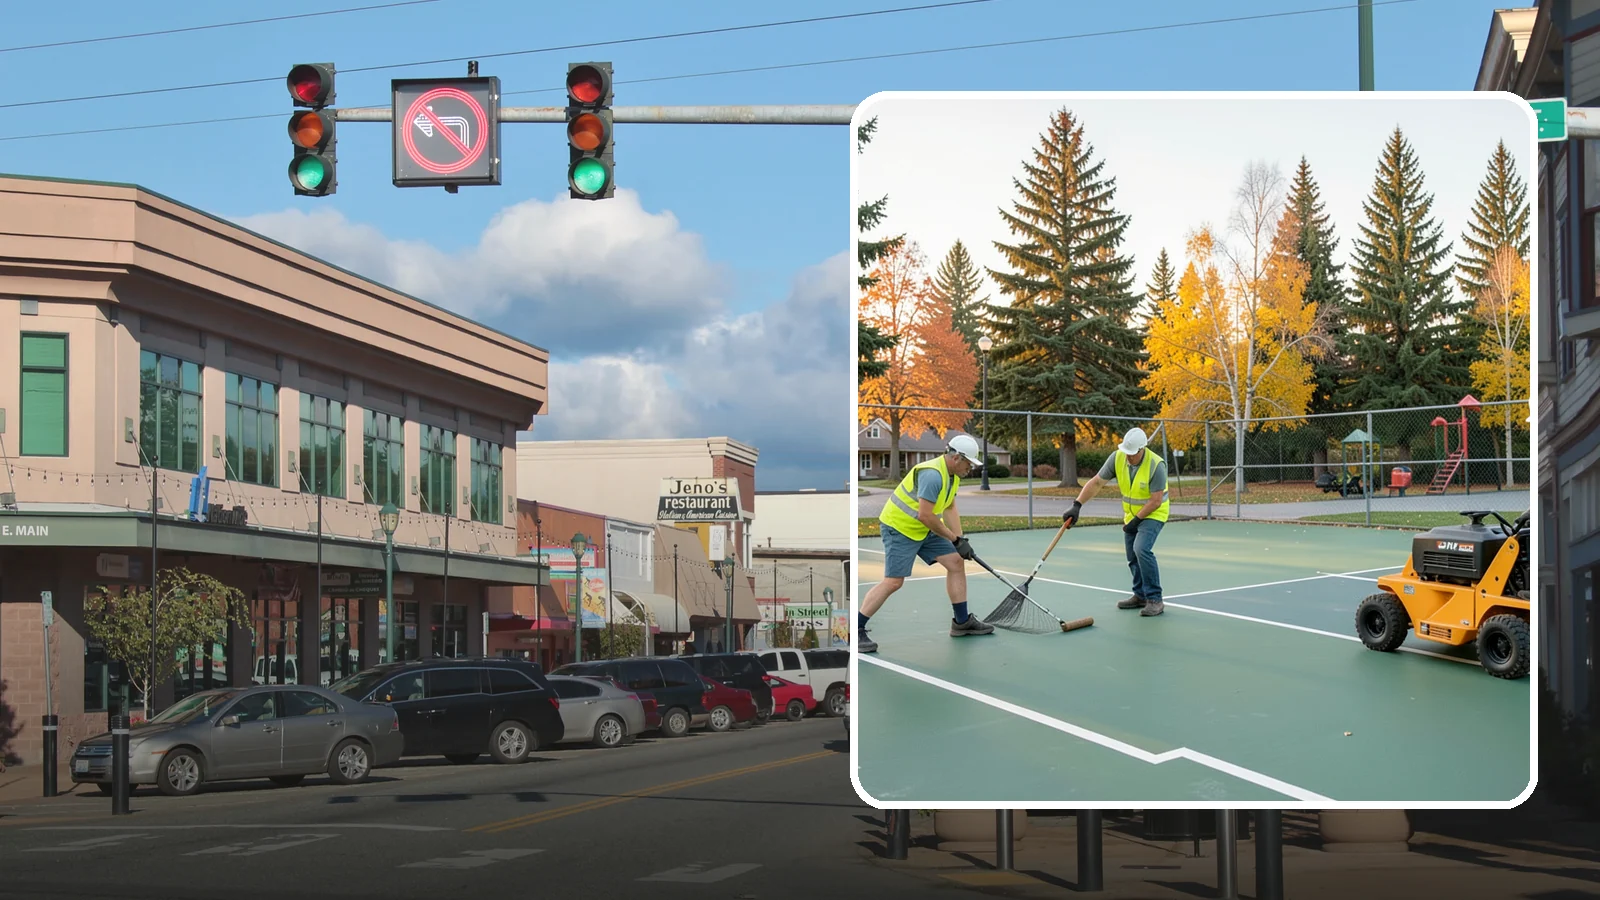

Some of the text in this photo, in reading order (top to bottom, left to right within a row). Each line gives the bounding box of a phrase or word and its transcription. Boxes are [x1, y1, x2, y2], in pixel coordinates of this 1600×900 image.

[670, 480, 727, 494] Jeno's
[665, 496, 731, 509] restaurant
[658, 510, 681, 520] Italian
[686, 510, 714, 519] American
[715, 509, 737, 519] Cuisine
[2, 525, 49, 536] E. MAIN
[797, 607, 828, 616] Street
[791, 619, 823, 627] lass
